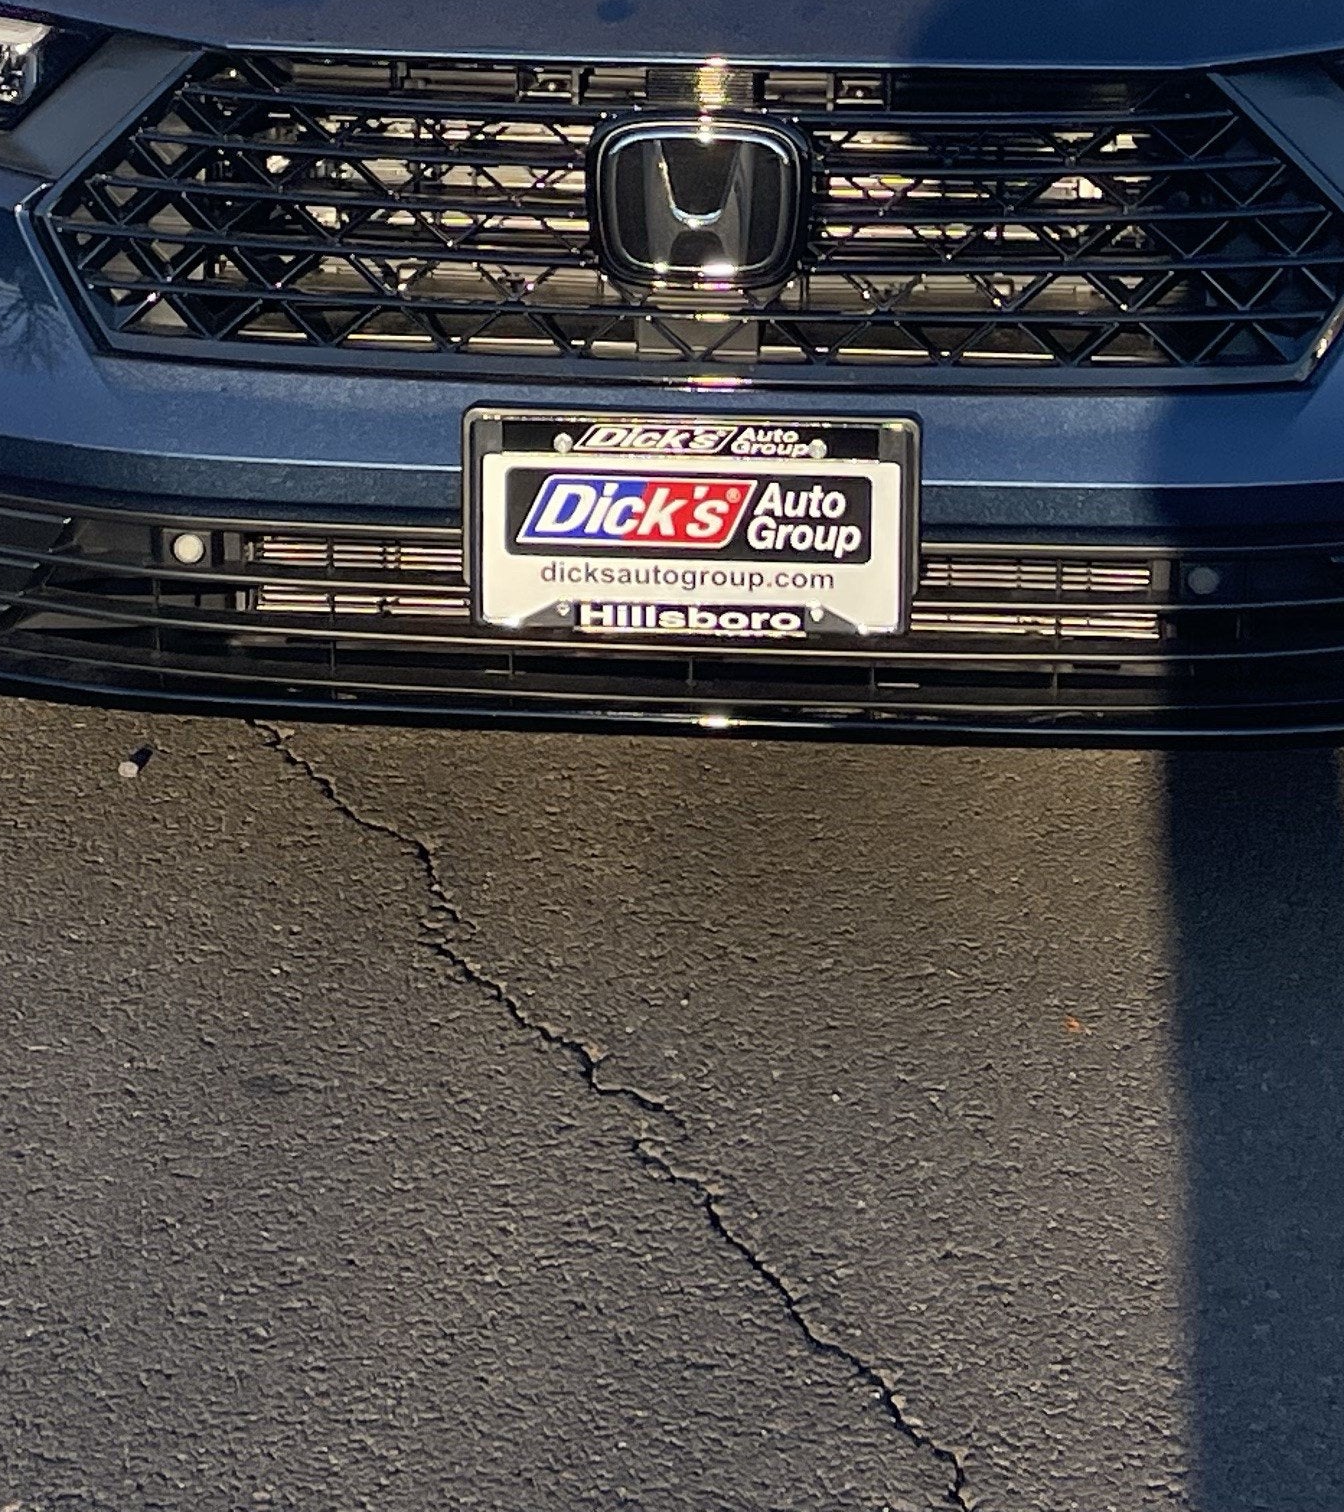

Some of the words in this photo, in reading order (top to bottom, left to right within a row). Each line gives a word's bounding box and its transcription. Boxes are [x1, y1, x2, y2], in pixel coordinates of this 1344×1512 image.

[591, 426, 722, 450] Dick's
[738, 427, 800, 442] Auto
[731, 440, 809, 458] Group
[535, 482, 729, 539] Dick's
[753, 483, 846, 519] Auto
[746, 517, 862, 559] Group
[541, 561, 835, 591] dicksautogroup.com
[580, 604, 802, 631] Hillsboro
